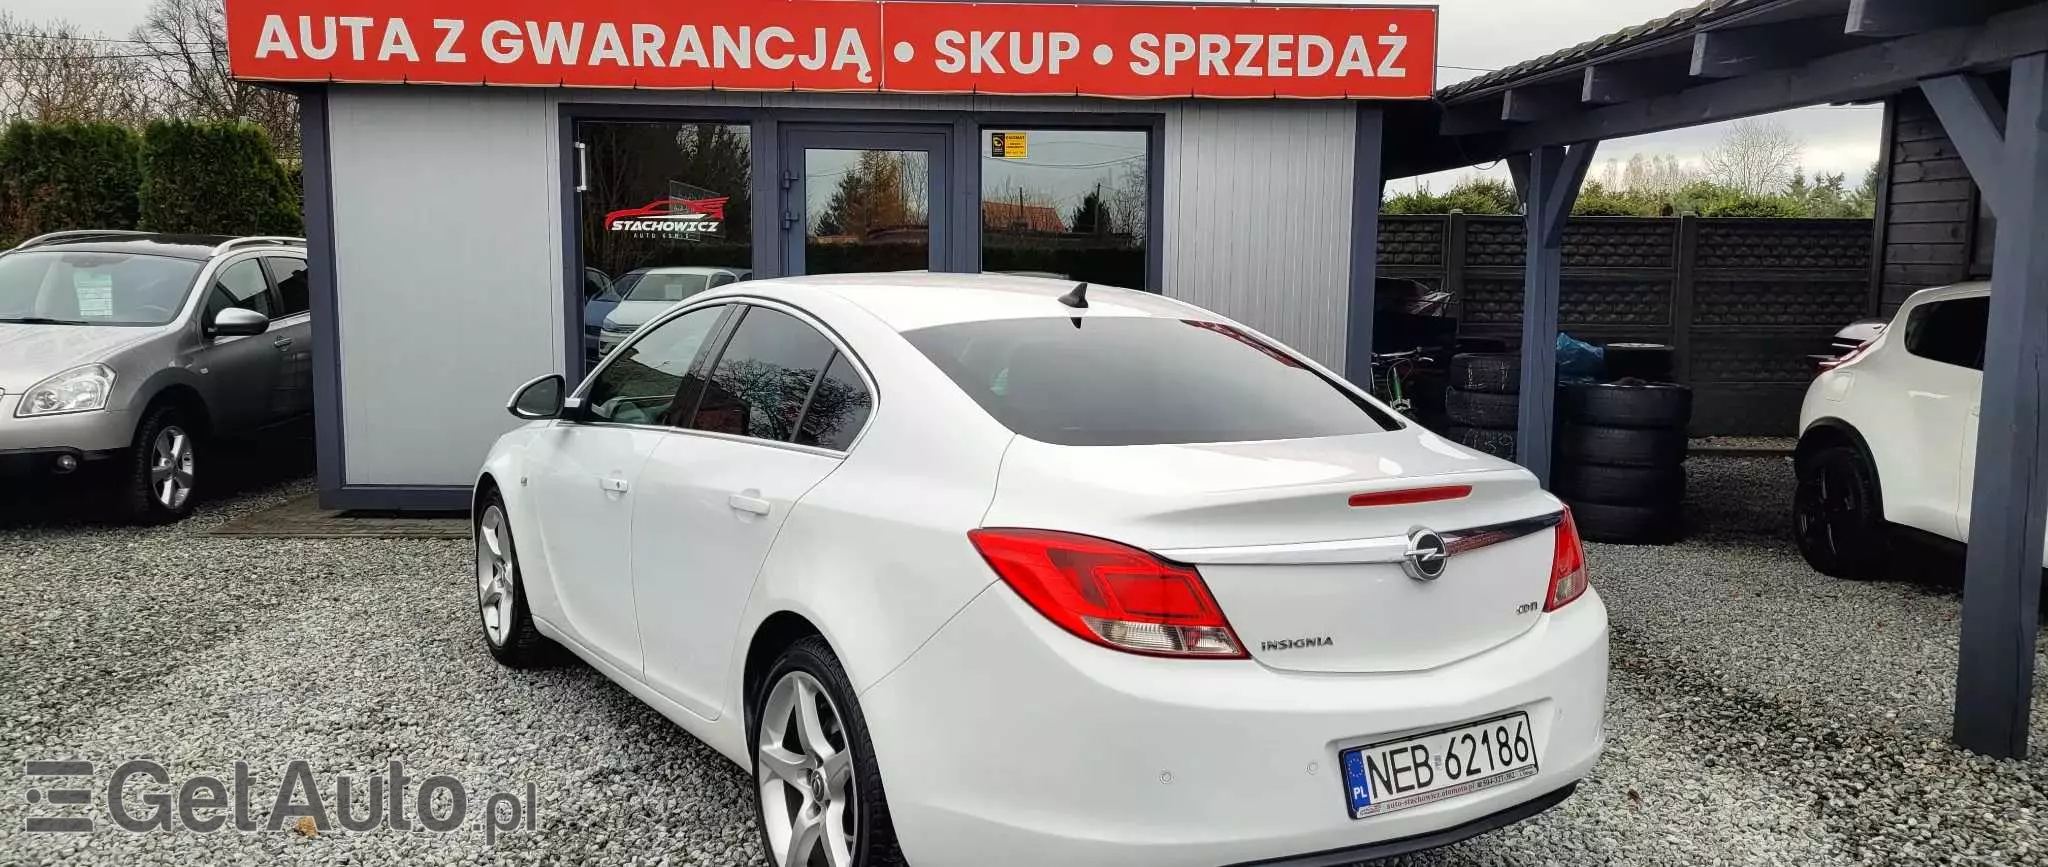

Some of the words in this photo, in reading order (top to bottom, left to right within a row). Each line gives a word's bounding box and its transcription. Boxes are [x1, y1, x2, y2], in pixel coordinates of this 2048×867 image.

[255, 14, 420, 63] AUTA
[433, 18, 467, 64] Z
[481, 19, 873, 84] GWARANCJĄ
[934, 30, 1081, 75] SKUP
[1129, 23, 1408, 78] SPRZEDAŻ
[611, 220, 720, 233] STACHOWICZ
[1261, 635, 1334, 652] INSIGNIA
[1366, 743, 1435, 799] NEB
[1444, 720, 1529, 780] 62186
[1353, 786, 1367, 800] PL
